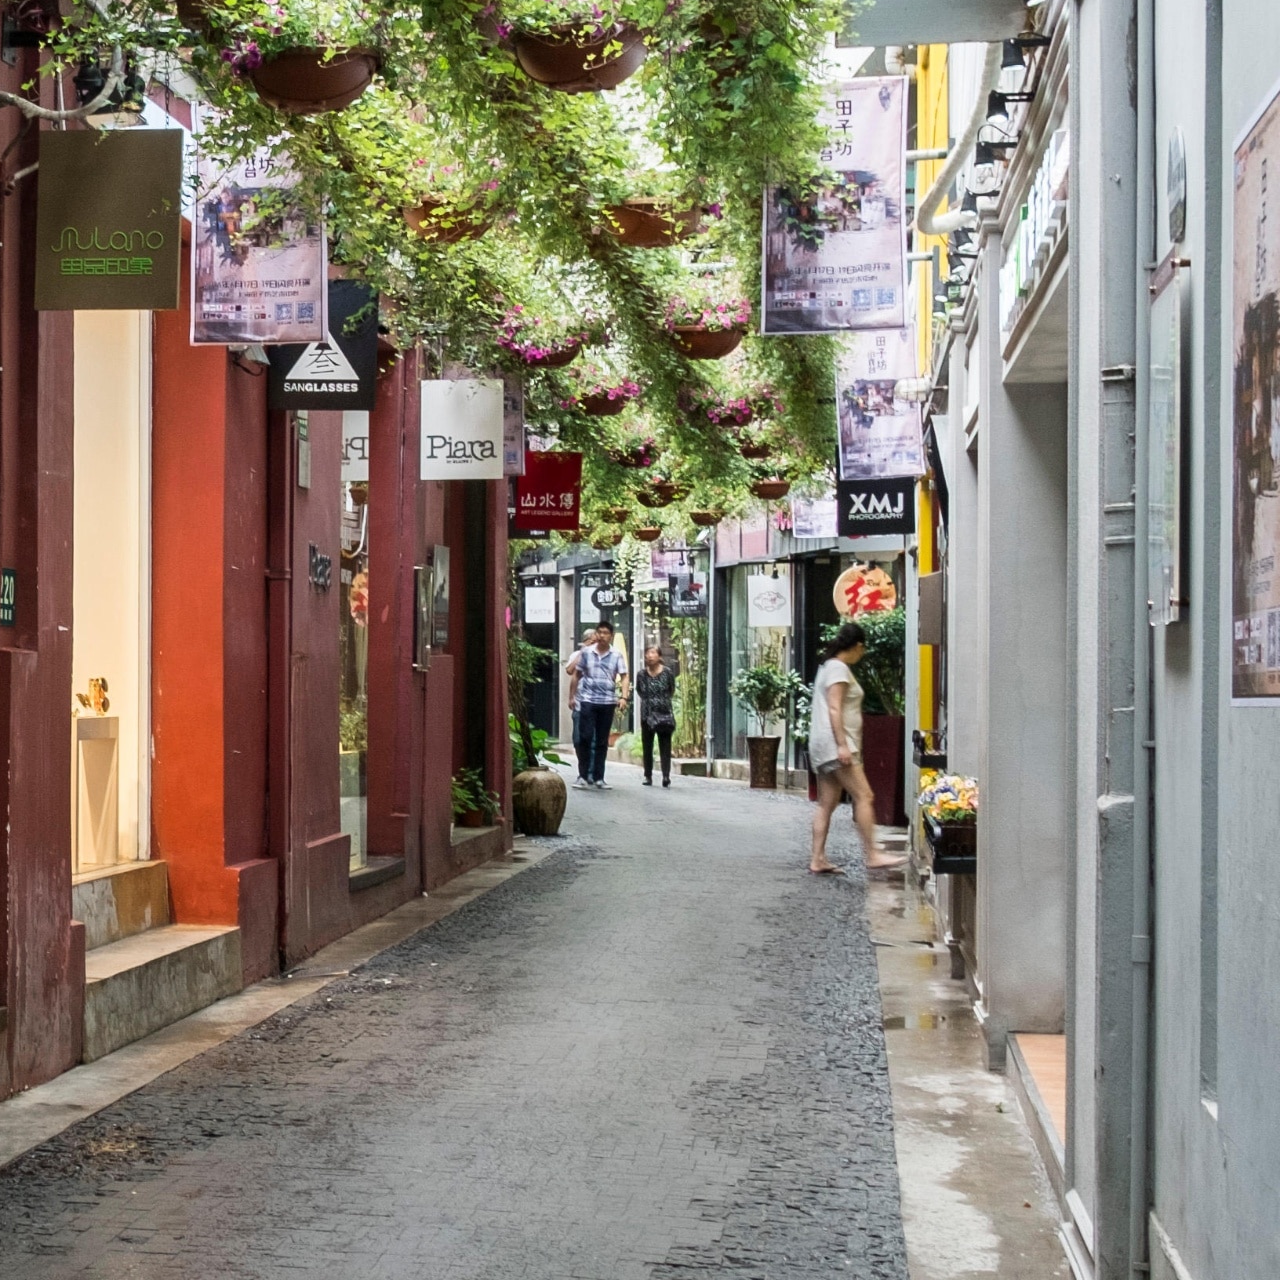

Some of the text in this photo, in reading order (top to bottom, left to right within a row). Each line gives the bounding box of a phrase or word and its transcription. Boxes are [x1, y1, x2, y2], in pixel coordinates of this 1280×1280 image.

[283, 382, 359, 393] SANGLASSES
[426, 435, 498, 461] Piara
[849, 492, 904, 514] XMJ
[848, 512, 904, 521] PHOTOGRAPHY
